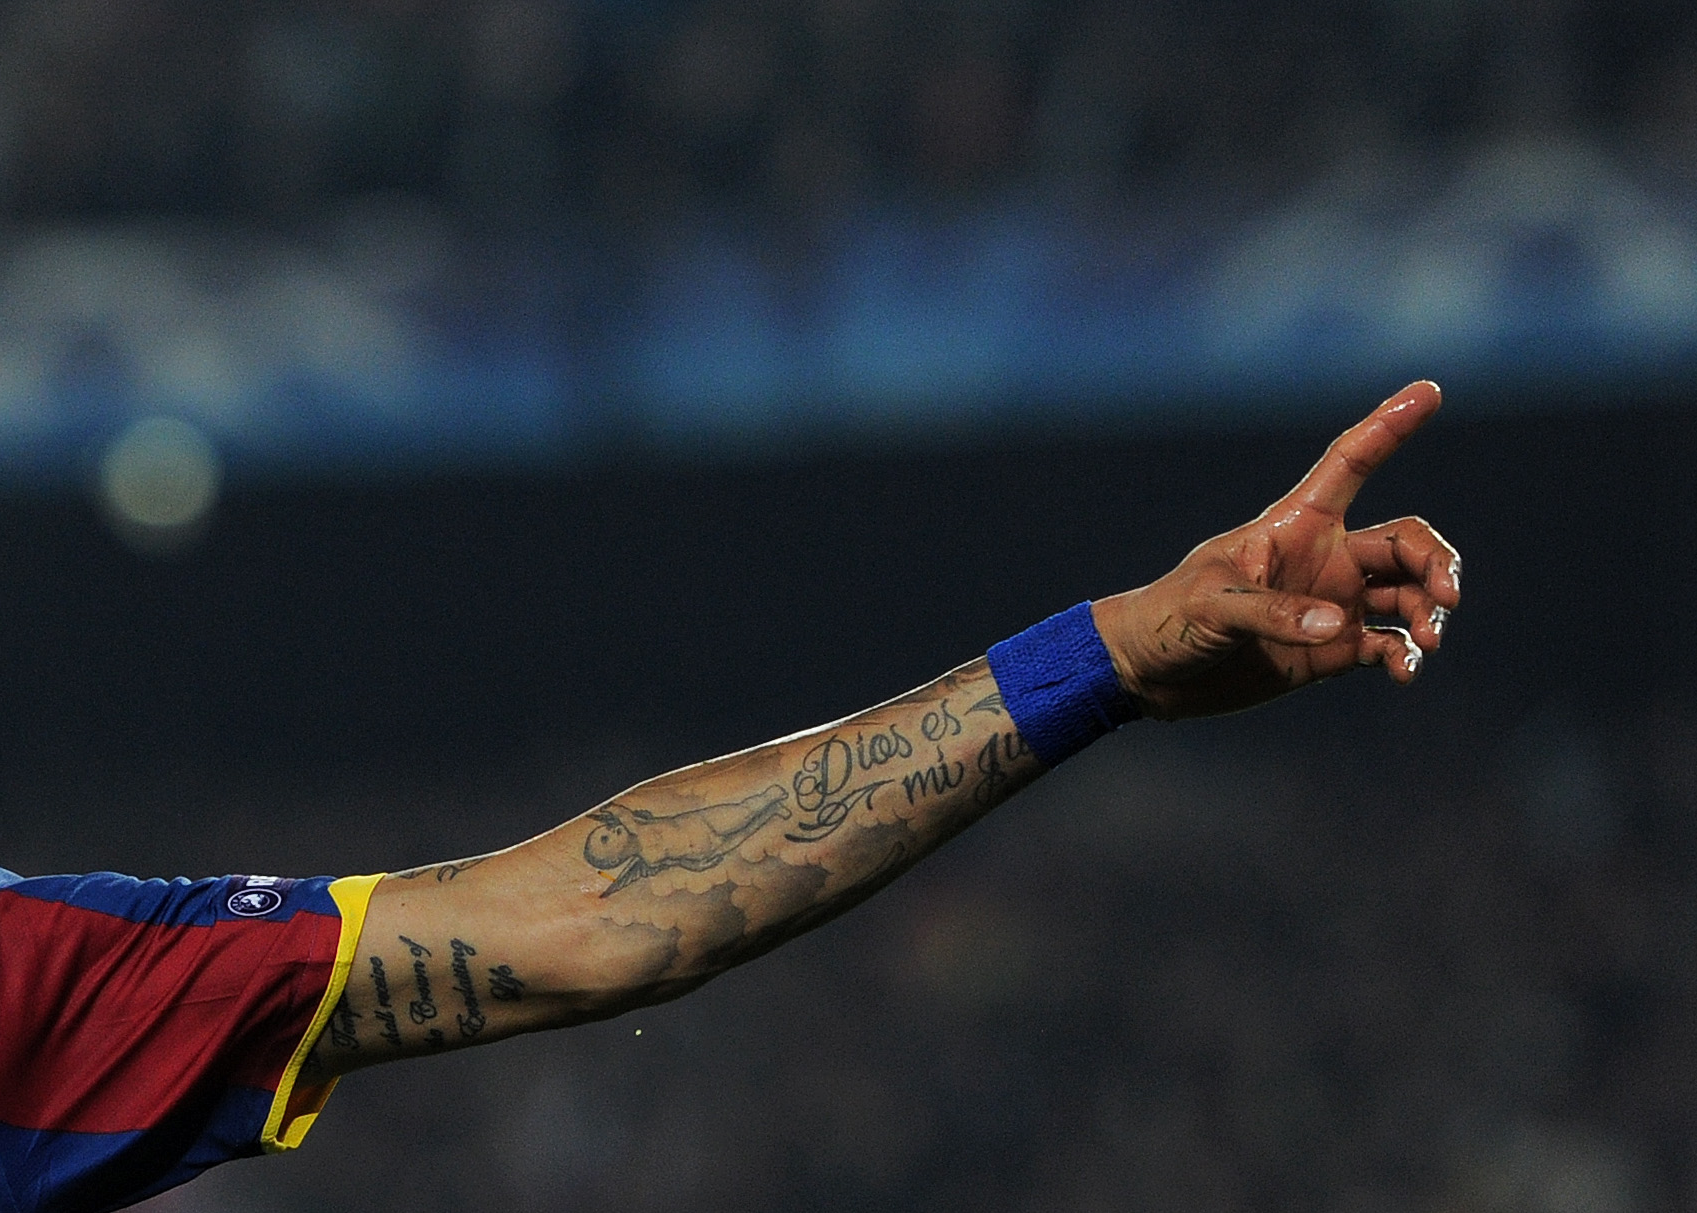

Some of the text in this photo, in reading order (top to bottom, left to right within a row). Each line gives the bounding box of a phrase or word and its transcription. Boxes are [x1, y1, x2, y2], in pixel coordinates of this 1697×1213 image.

[793, 698, 963, 812] Dios es
[903, 745, 964, 804] mi
[398, 934, 433, 959] of
[369, 955, 394, 1008] receive
[408, 958, 438, 1025] Crown
